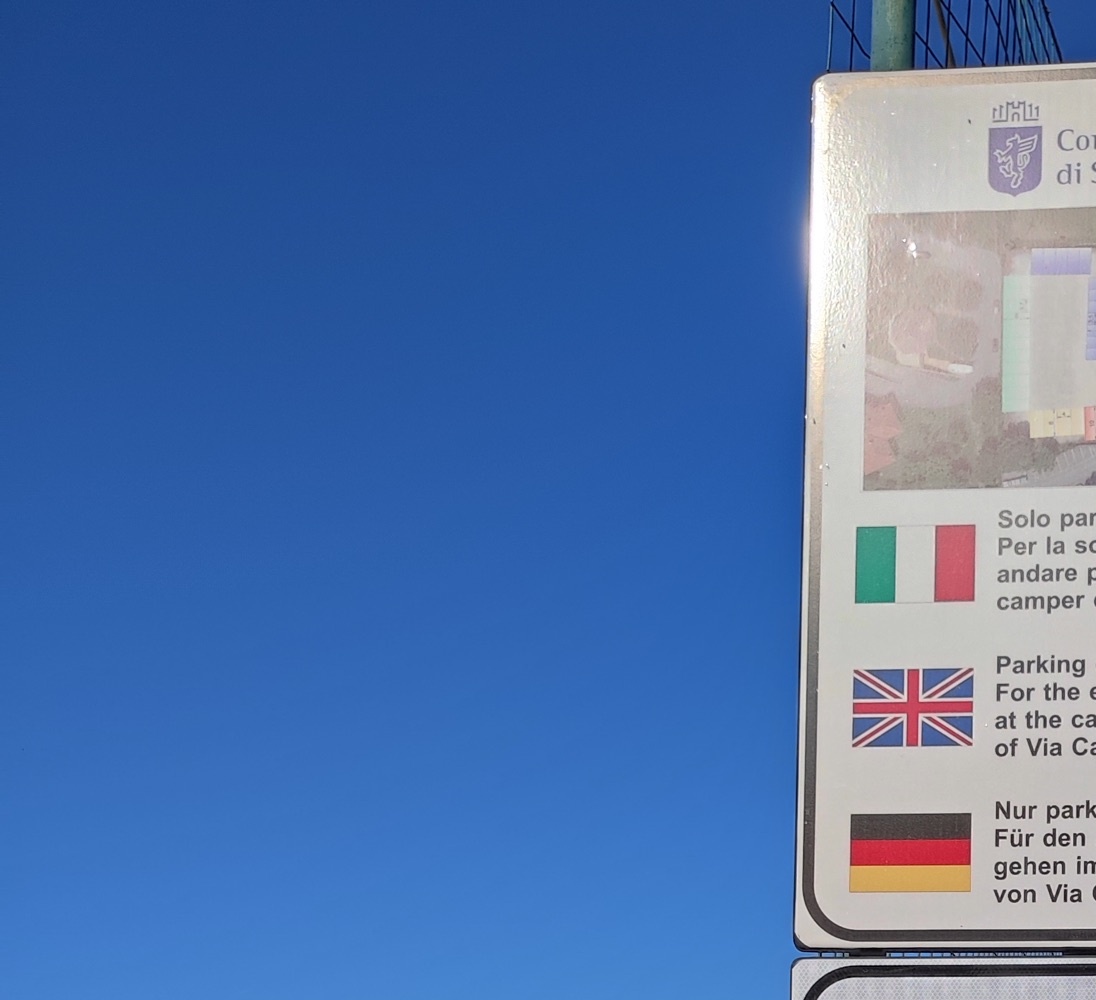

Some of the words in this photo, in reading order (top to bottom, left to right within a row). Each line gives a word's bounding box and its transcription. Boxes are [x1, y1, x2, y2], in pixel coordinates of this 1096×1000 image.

[1056, 161, 1084, 185] di
[997, 508, 1051, 529] Solo
[998, 537, 1038, 556] Per
[1046, 535, 1066, 556] la
[996, 563, 1078, 584] andare
[996, 594, 1086, 615] camper
[996, 654, 1086, 679] Parking
[995, 682, 1036, 703] For
[1042, 681, 1081, 702] the
[994, 711, 1017, 730] at
[1024, 709, 1062, 730] the
[994, 737, 1020, 758] of
[1025, 737, 1063, 757] Via
[994, 800, 1038, 820] Nur
[994, 828, 1035, 848] Für
[1042, 827, 1086, 848] den
[993, 855, 1067, 881] gehen
[992, 888, 1037, 904] von
[1045, 883, 1083, 904] Via
